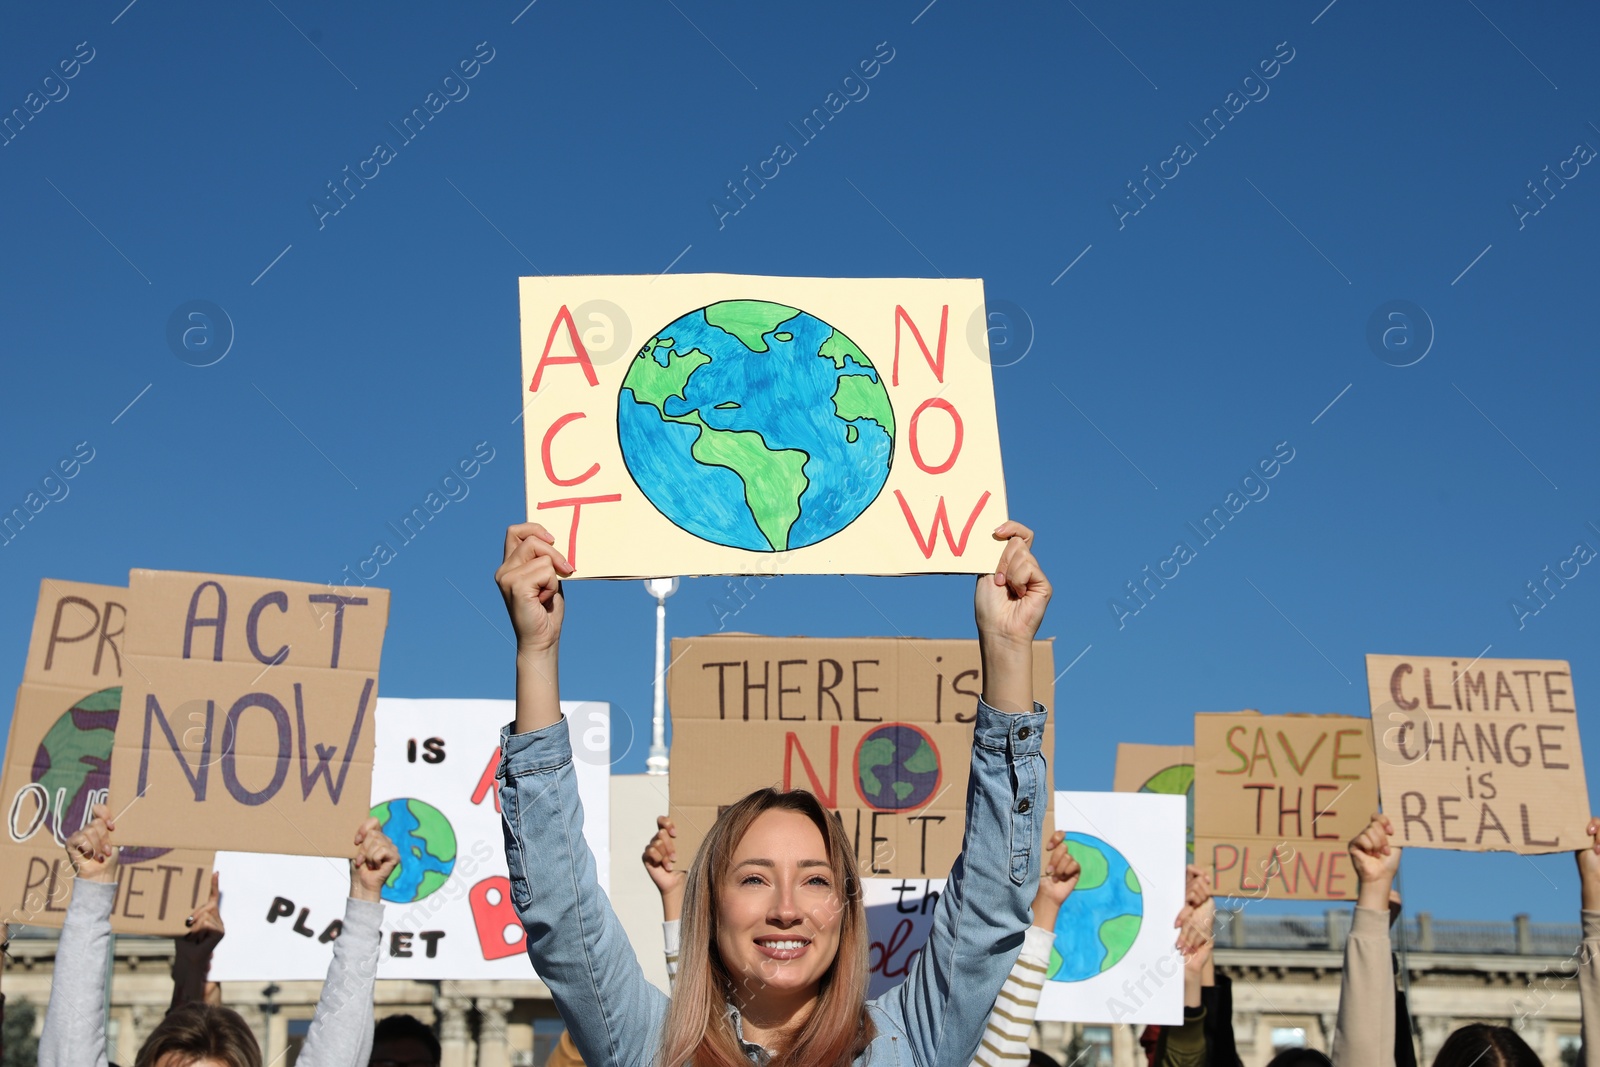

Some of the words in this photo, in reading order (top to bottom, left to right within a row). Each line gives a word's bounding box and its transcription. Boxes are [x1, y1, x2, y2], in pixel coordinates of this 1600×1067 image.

[529, 304, 622, 572] ACT
[892, 304, 991, 560] NOW
[182, 581, 369, 669] ACT
[702, 658, 883, 723] THERE
[137, 677, 375, 807] NOW
[407, 736, 447, 765] IS
[1216, 725, 1363, 781] SAVE
[1397, 720, 1570, 770] CHANGE
[8, 782, 110, 848] OU
[1243, 784, 1341, 840] THE
[1401, 791, 1560, 847] REAL
[1213, 844, 1359, 897] PLANE
[265, 895, 447, 959] PLAET
